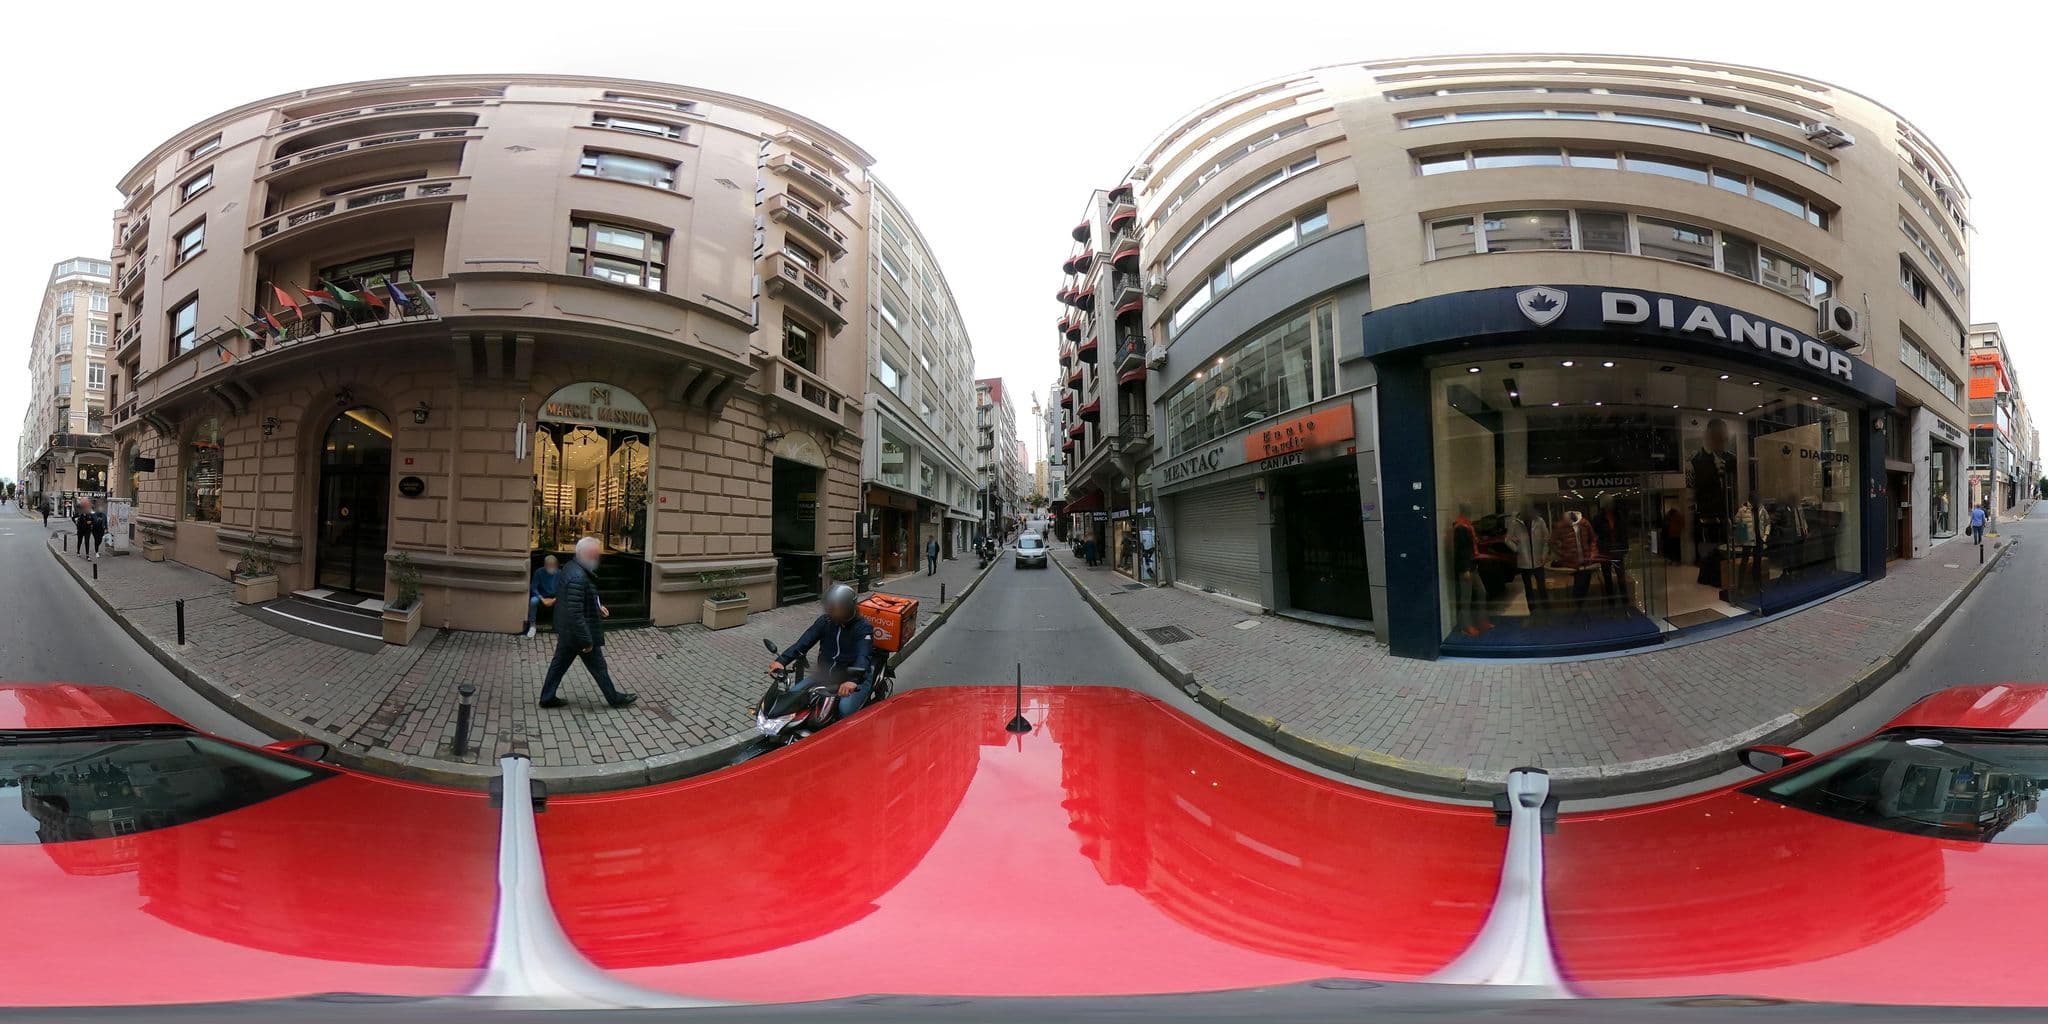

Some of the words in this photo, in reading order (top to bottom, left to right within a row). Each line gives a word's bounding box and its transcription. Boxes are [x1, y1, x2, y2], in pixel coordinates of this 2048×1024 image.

[1601, 291, 1853, 381] DIANDOR
[546, 402, 593, 420] MARCEL
[597, 407, 649, 427] MASSIMO
[1163, 448, 1221, 482] MENTAÇ
[1260, 457, 1279, 470] CAN
[1800, 448, 1850, 463] DIANDOR
